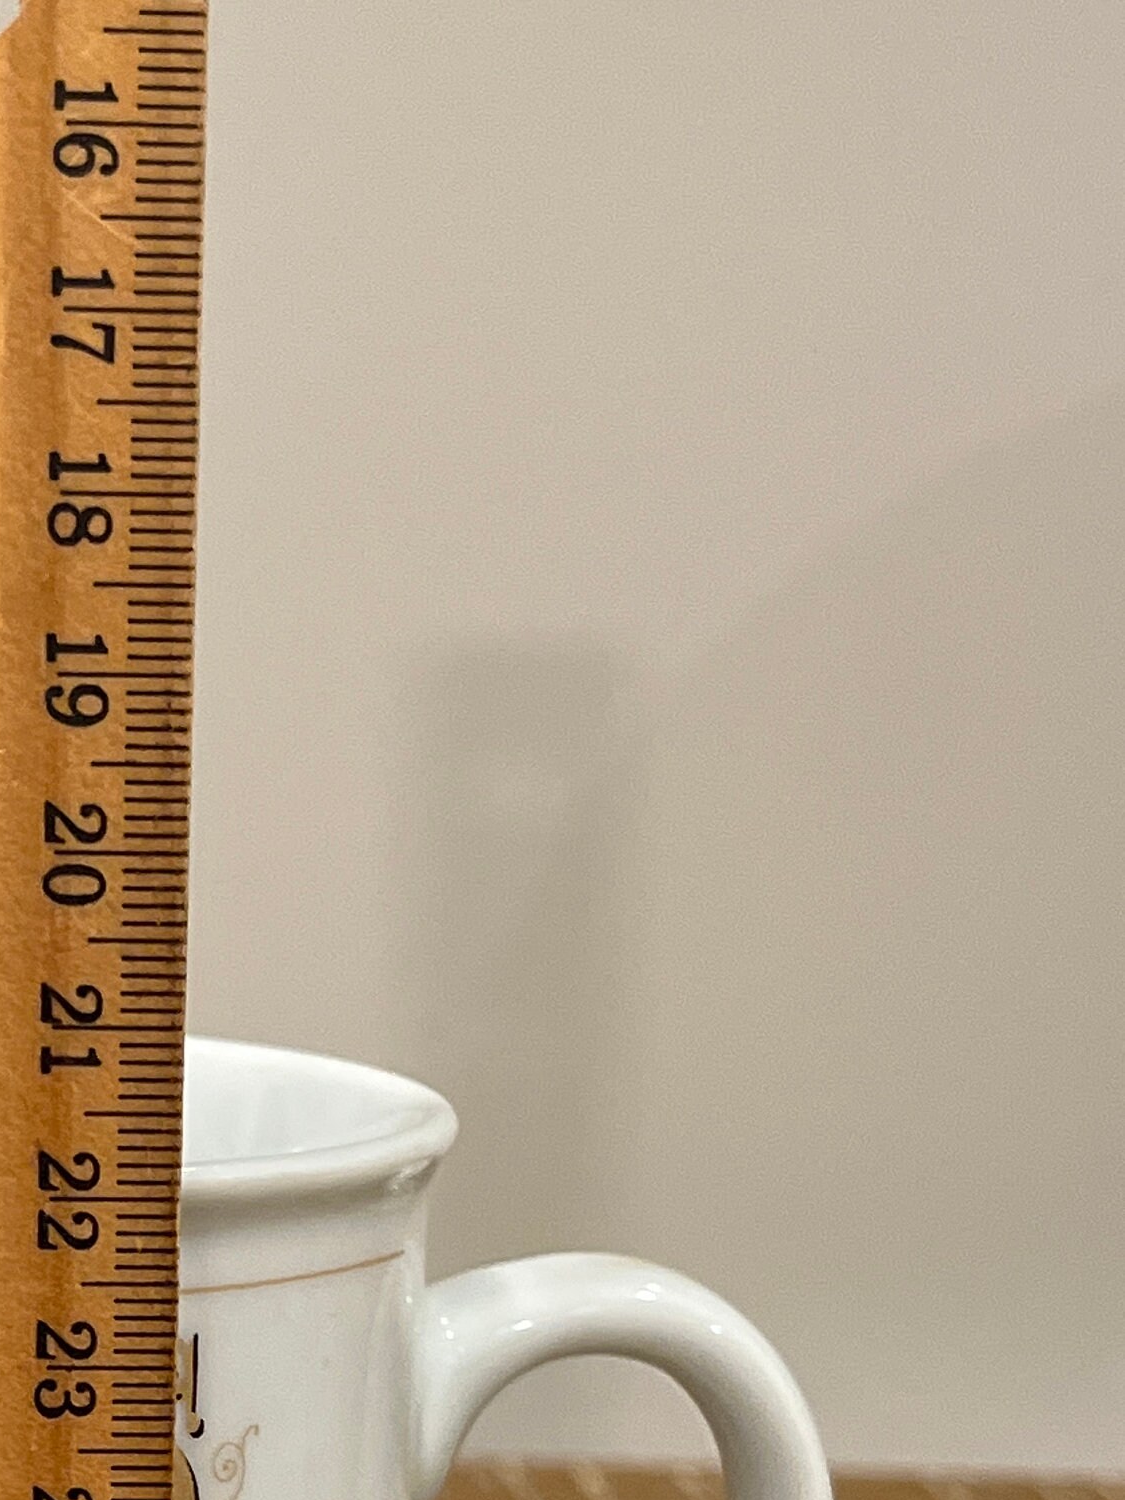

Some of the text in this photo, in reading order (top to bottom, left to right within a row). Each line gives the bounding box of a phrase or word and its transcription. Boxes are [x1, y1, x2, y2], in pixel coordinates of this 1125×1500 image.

[53, 80, 120, 178] 16
[51, 267, 115, 364] 17
[47, 452, 114, 546] 18
[44, 633, 110, 727] 19
[42, 800, 107, 906] 20
[39, 983, 104, 1074] 21
[37, 1151, 100, 1250] 22
[33, 1320, 98, 1419] 23
